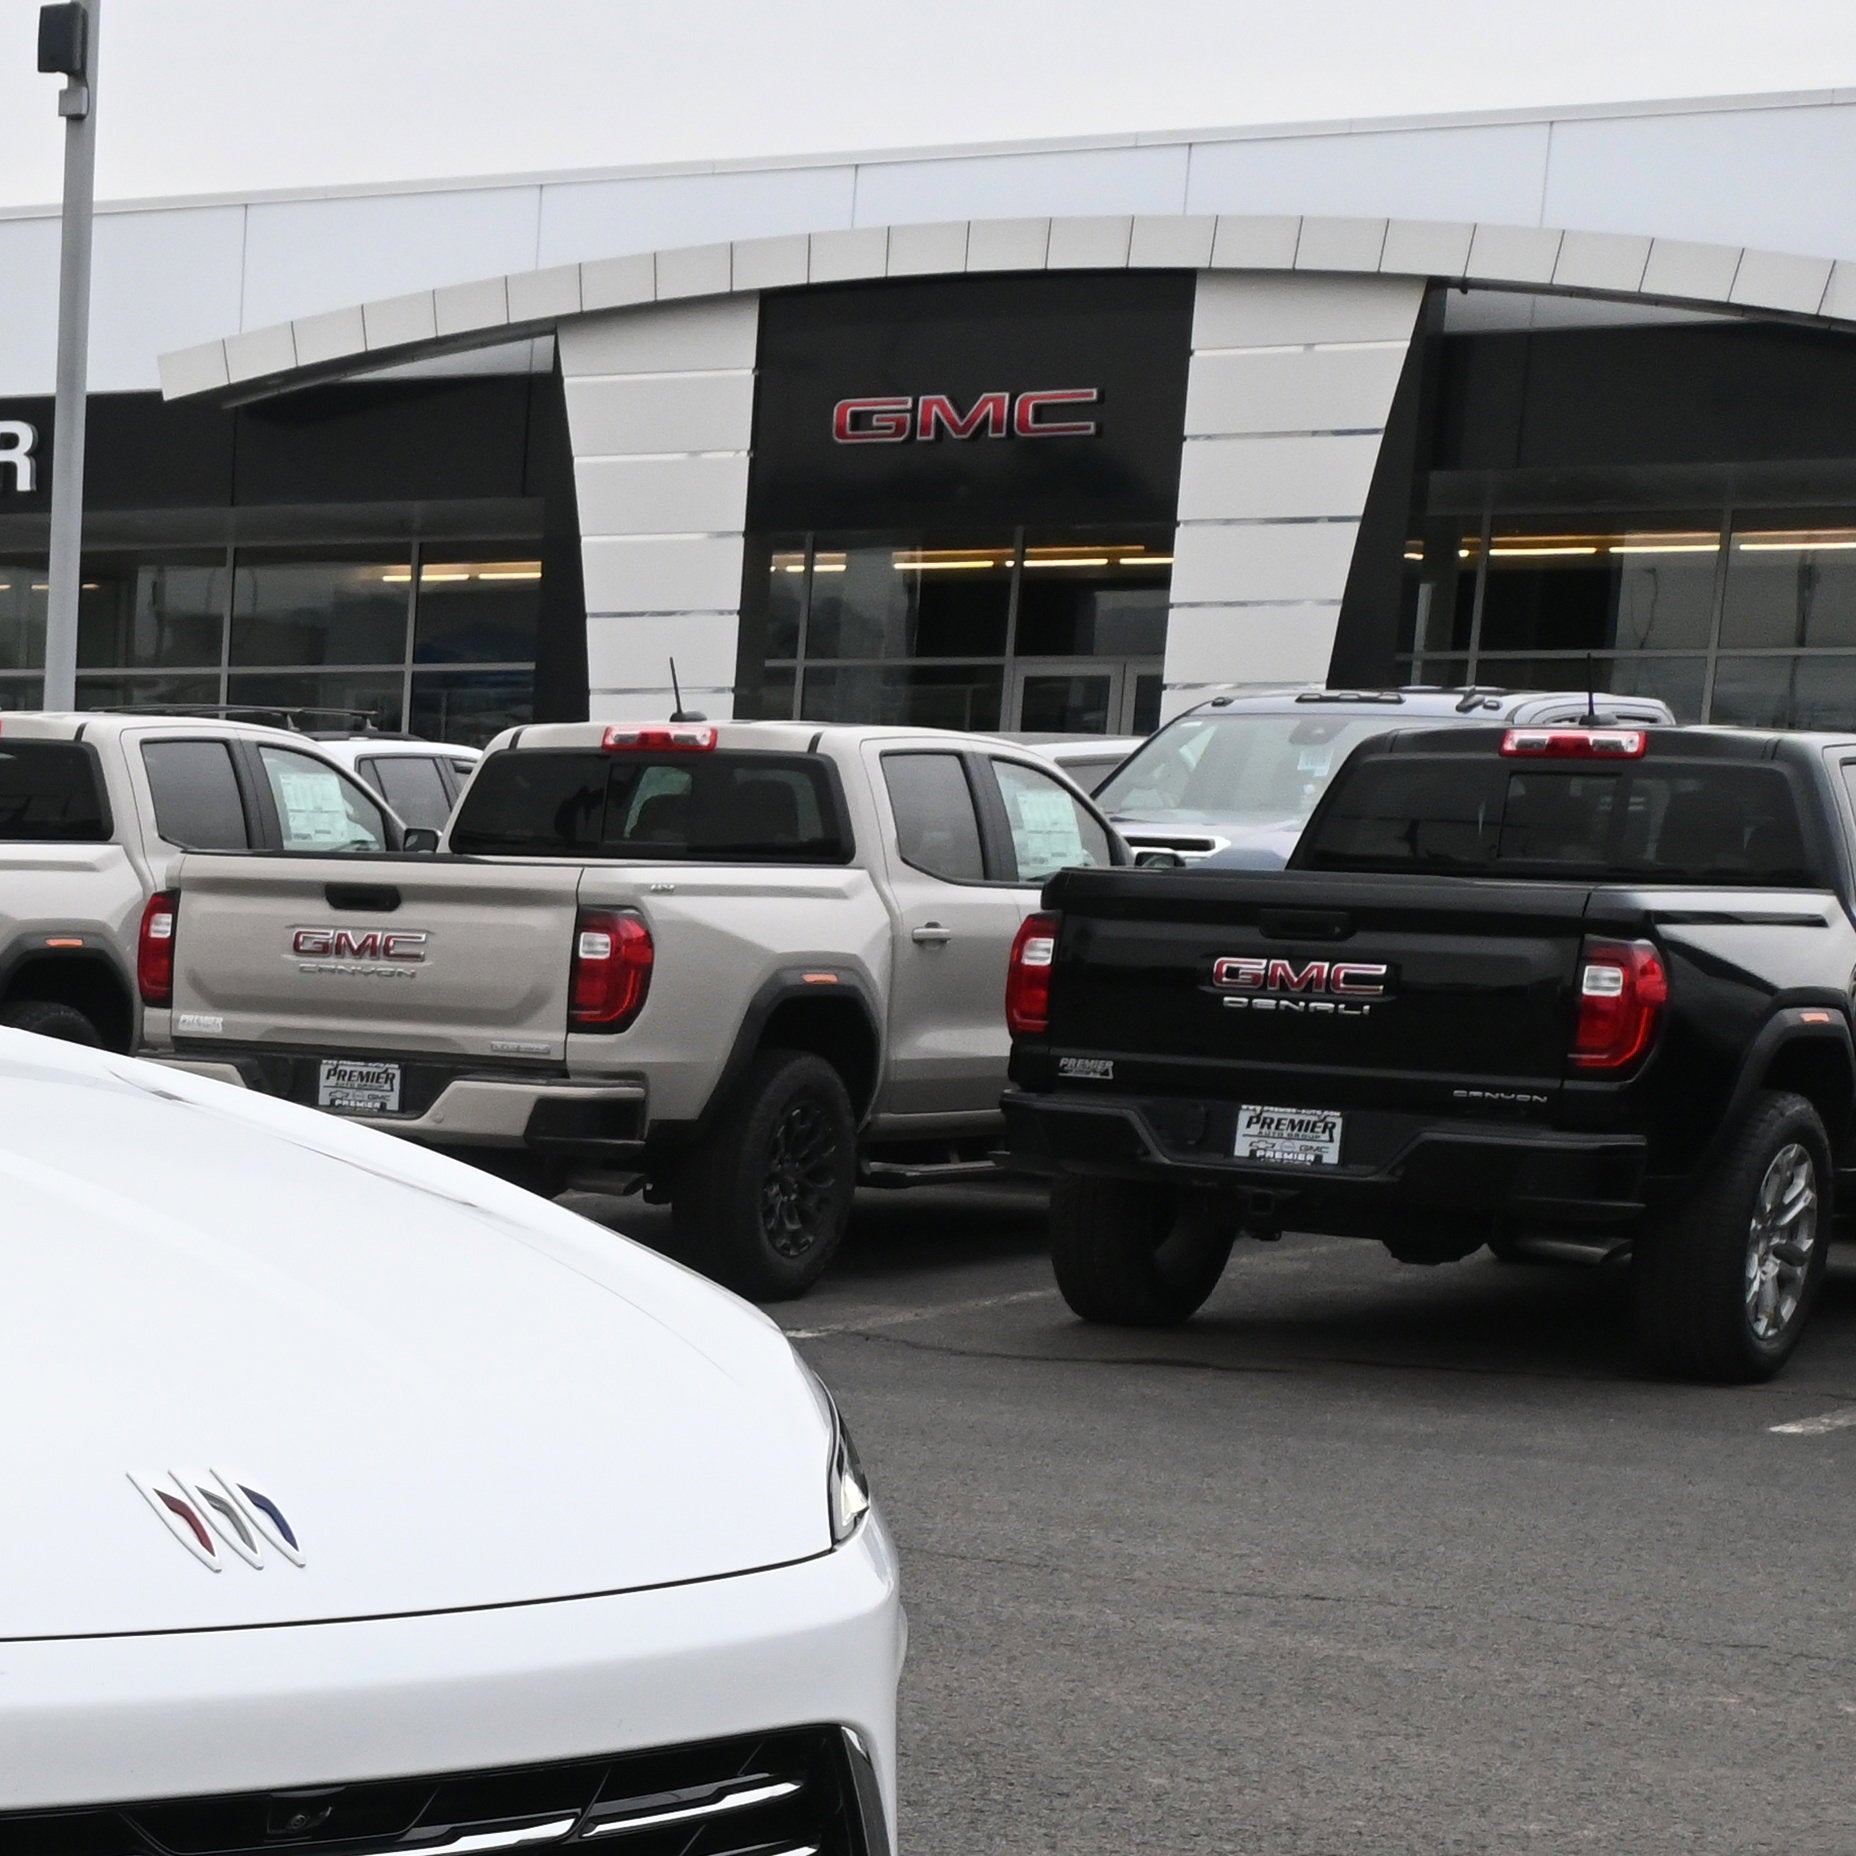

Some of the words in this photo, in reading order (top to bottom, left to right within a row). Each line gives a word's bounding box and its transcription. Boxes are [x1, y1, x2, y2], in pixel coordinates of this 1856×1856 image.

[833, 388, 1098, 442] GMC
[292, 928, 426, 962] GMC
[298, 963, 417, 979] CANYON
[1213, 956, 1387, 995] GMC
[1223, 996, 1371, 1015] DENALI
[326, 1067, 395, 1089] PREMIER
[334, 1099, 381, 1109] PREMIER
[1452, 1089, 1548, 1103] CANYON
[1245, 1115, 1336, 1140] PREMIER
[1256, 1149, 1316, 1162] PREMIER
